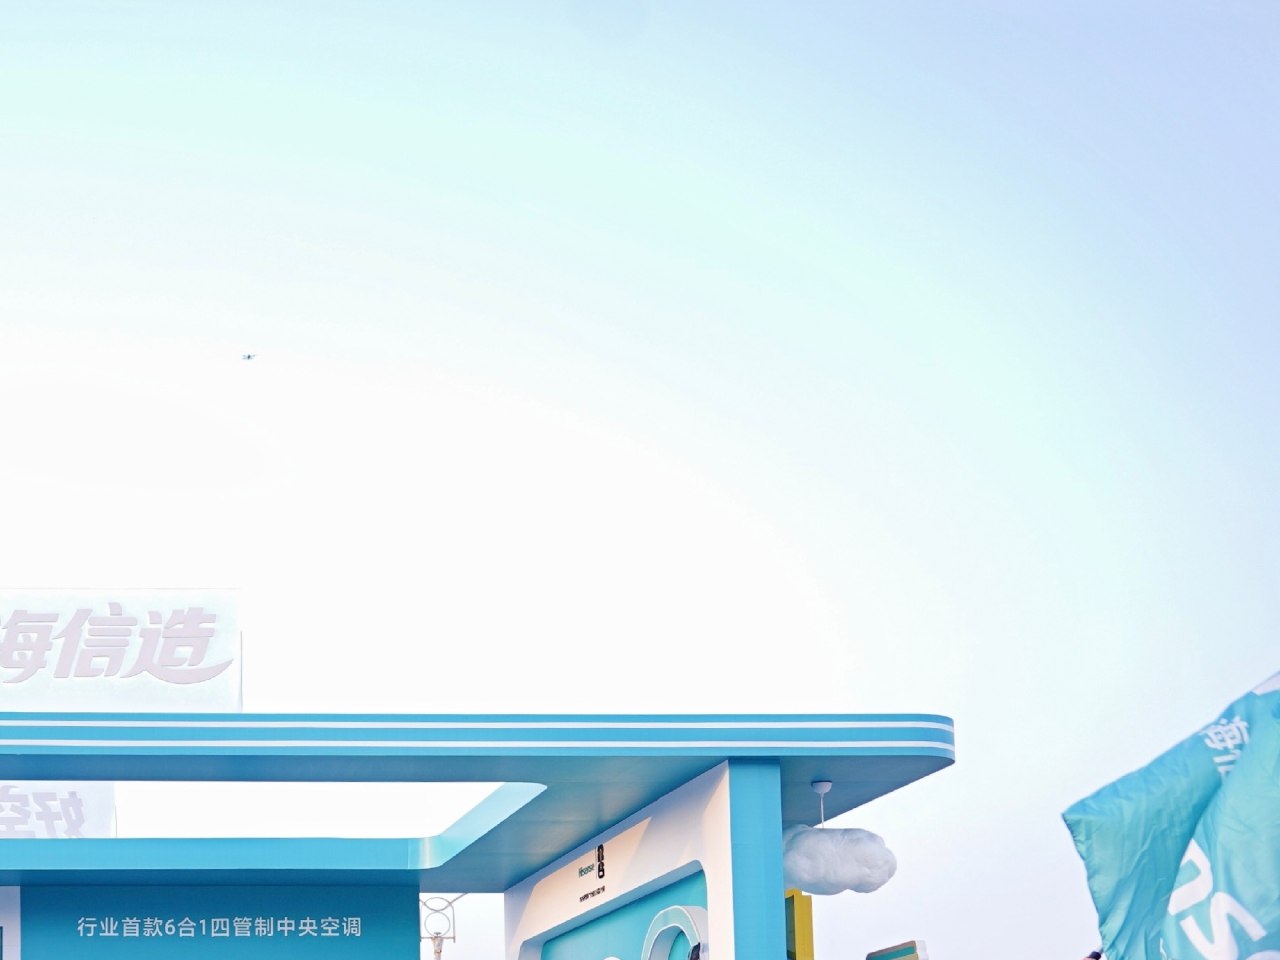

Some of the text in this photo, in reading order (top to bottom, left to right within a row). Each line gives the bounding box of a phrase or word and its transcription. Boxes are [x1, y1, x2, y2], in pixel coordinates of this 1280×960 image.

[77, 916, 362, 938] 行业首款6合1四管制中央空调
